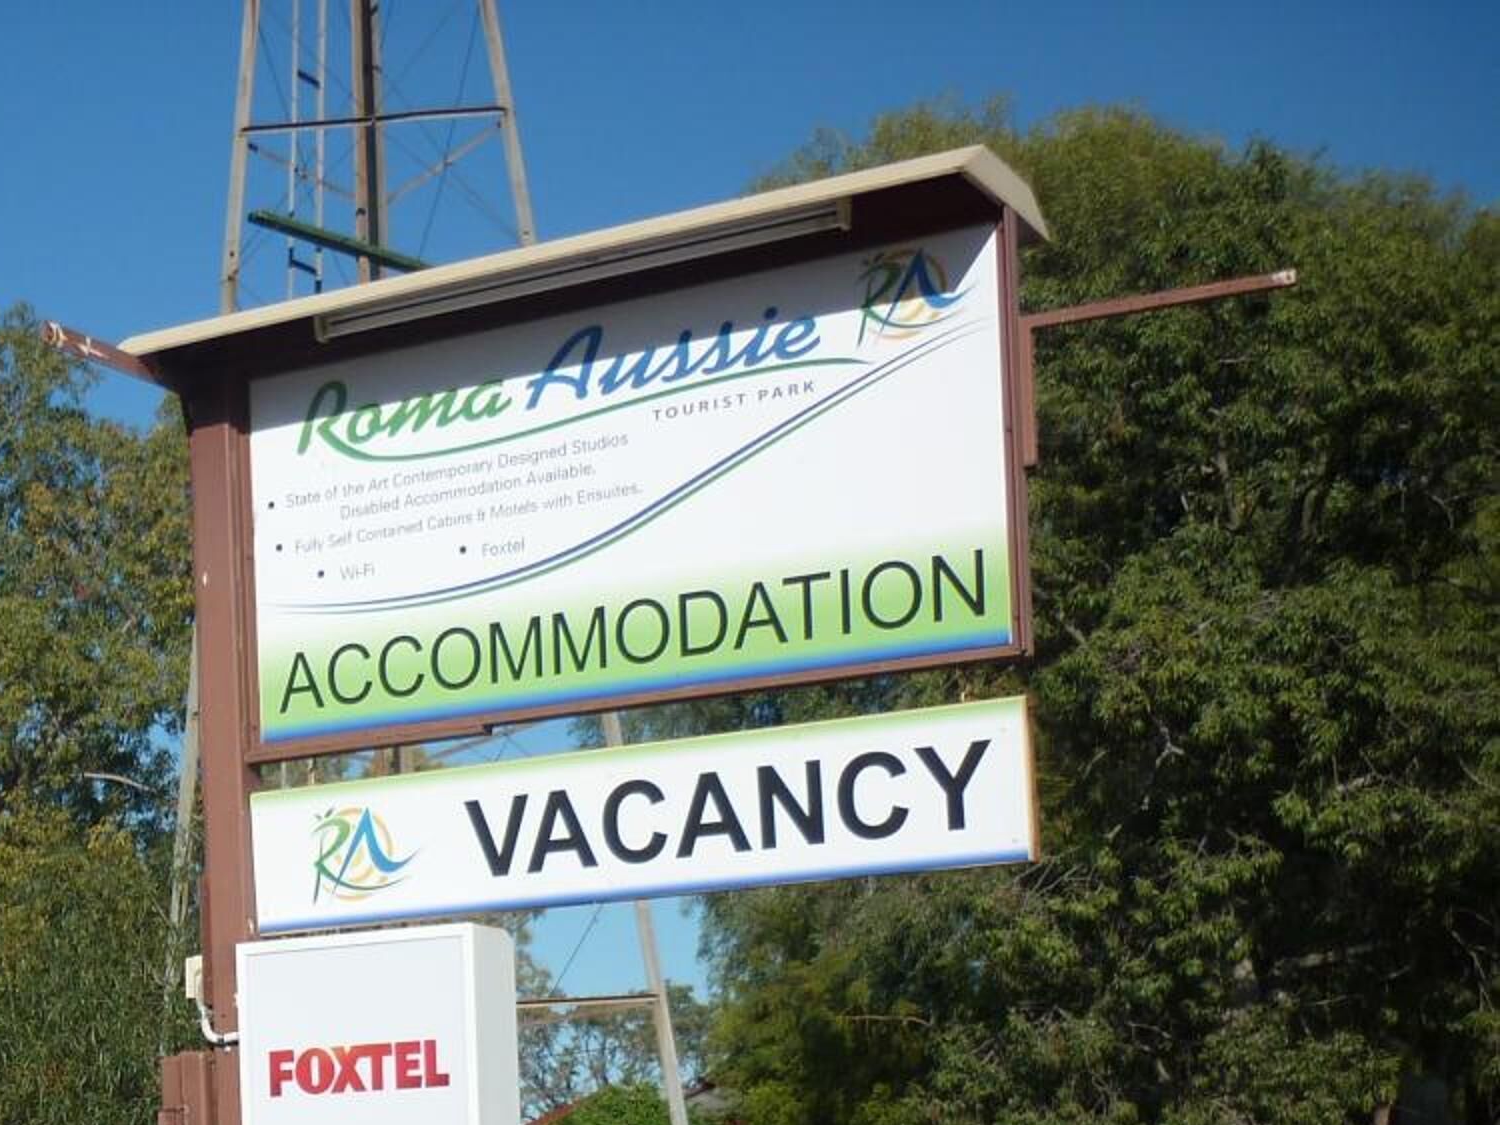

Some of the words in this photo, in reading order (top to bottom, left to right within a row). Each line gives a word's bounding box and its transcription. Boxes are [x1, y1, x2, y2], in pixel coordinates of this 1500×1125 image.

[296, 380, 512, 460] Roma
[525, 306, 822, 410] Aussie
[653, 393, 748, 422] TOURIST
[757, 380, 816, 402] PARK
[284, 491, 321, 509] State
[324, 485, 338, 500] of
[341, 482, 365, 499] the
[367, 477, 389, 493] Art
[392, 460, 493, 488] Contemporary
[497, 444, 568, 470] Designed
[571, 433, 629, 456] Studios
[339, 497, 399, 521] Disabled
[403, 476, 522, 507] Accommodation
[525, 462, 597, 486] Available.
[294, 537, 324, 555] Fully
[328, 531, 353, 548] Self
[356, 520, 423, 543] Contained
[427, 511, 473, 531] Cabins
[490, 499, 540, 519] Motels
[541, 493, 573, 510] with
[481, 537, 526, 558] Foxtel
[339, 562, 376, 581] Wi-Fi
[279, 548, 986, 713] ACCOMMODATION
[464, 739, 992, 877] VACANCY
[268, 1038, 451, 1098] FOXTEL
